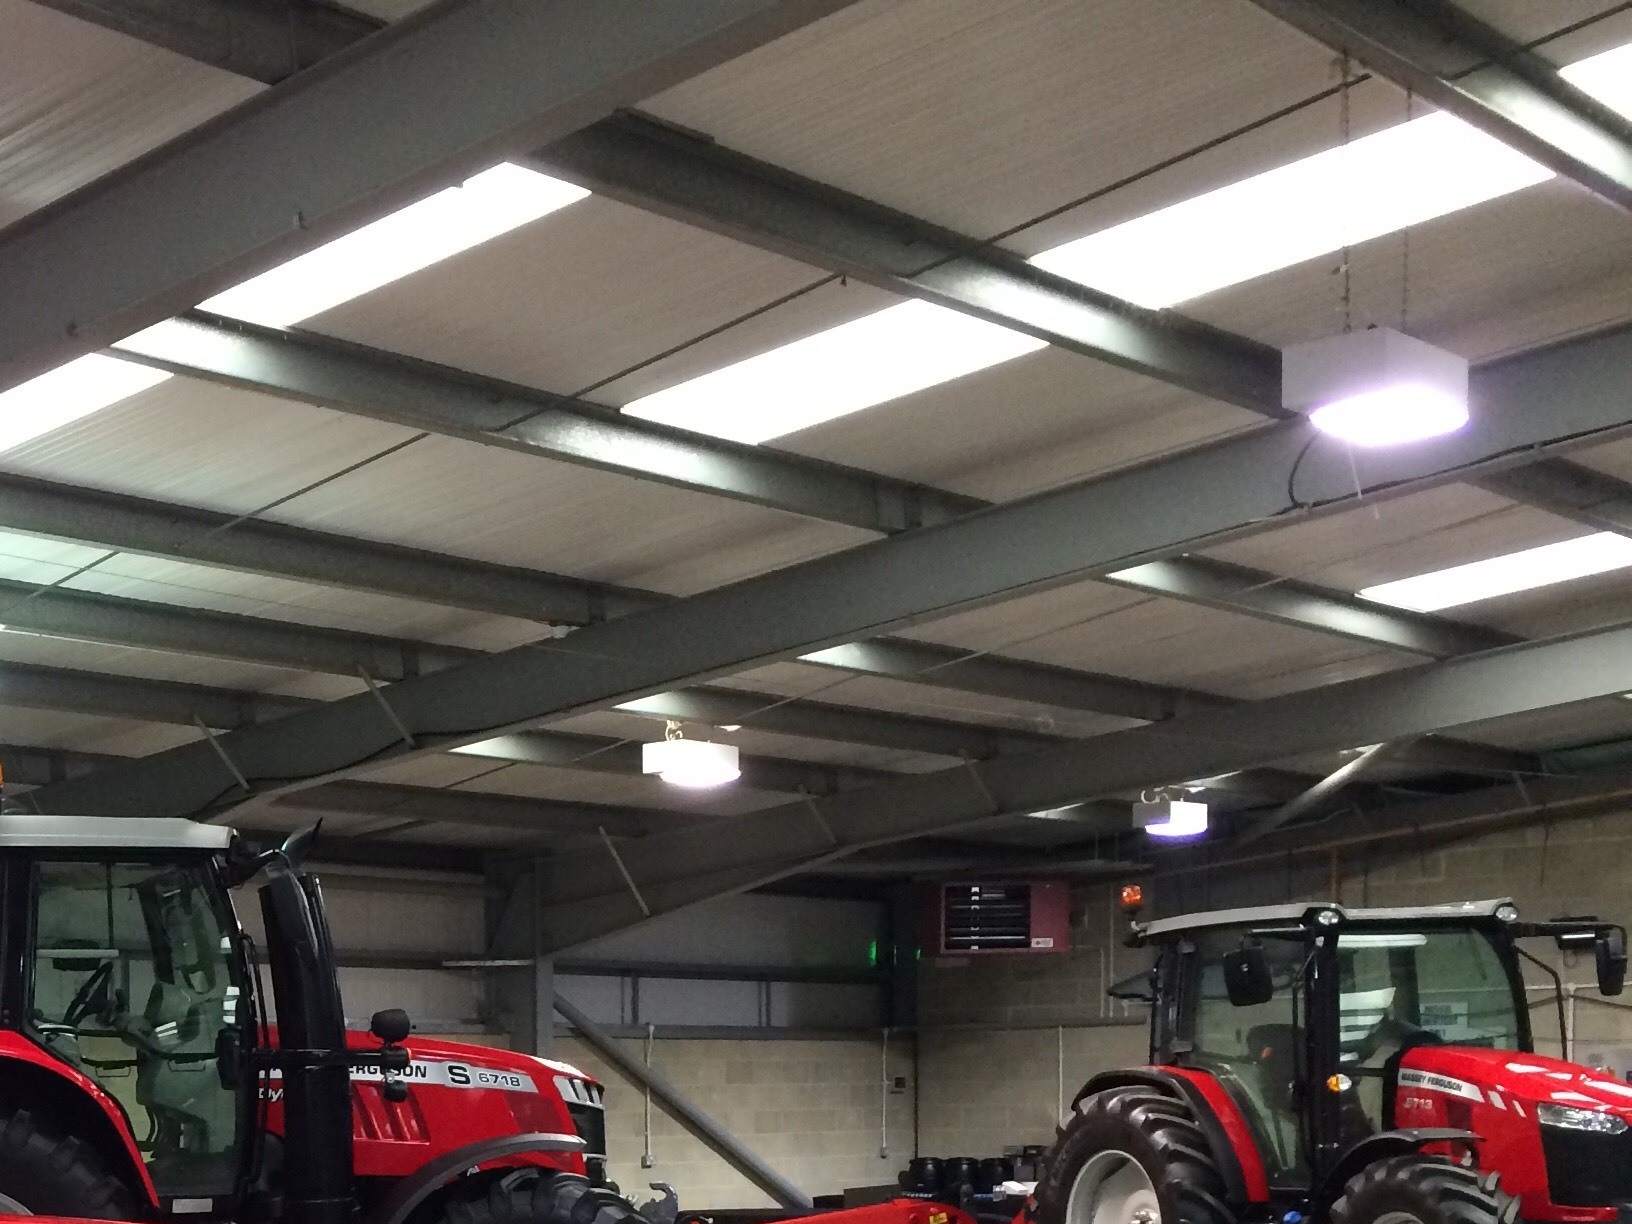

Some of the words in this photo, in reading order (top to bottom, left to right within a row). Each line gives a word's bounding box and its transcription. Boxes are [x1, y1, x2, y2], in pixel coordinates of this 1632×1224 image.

[448, 1065, 471, 1085] S
[478, 1072, 521, 1088] 6718
[1428, 1076, 1463, 1092] FERGUSON
